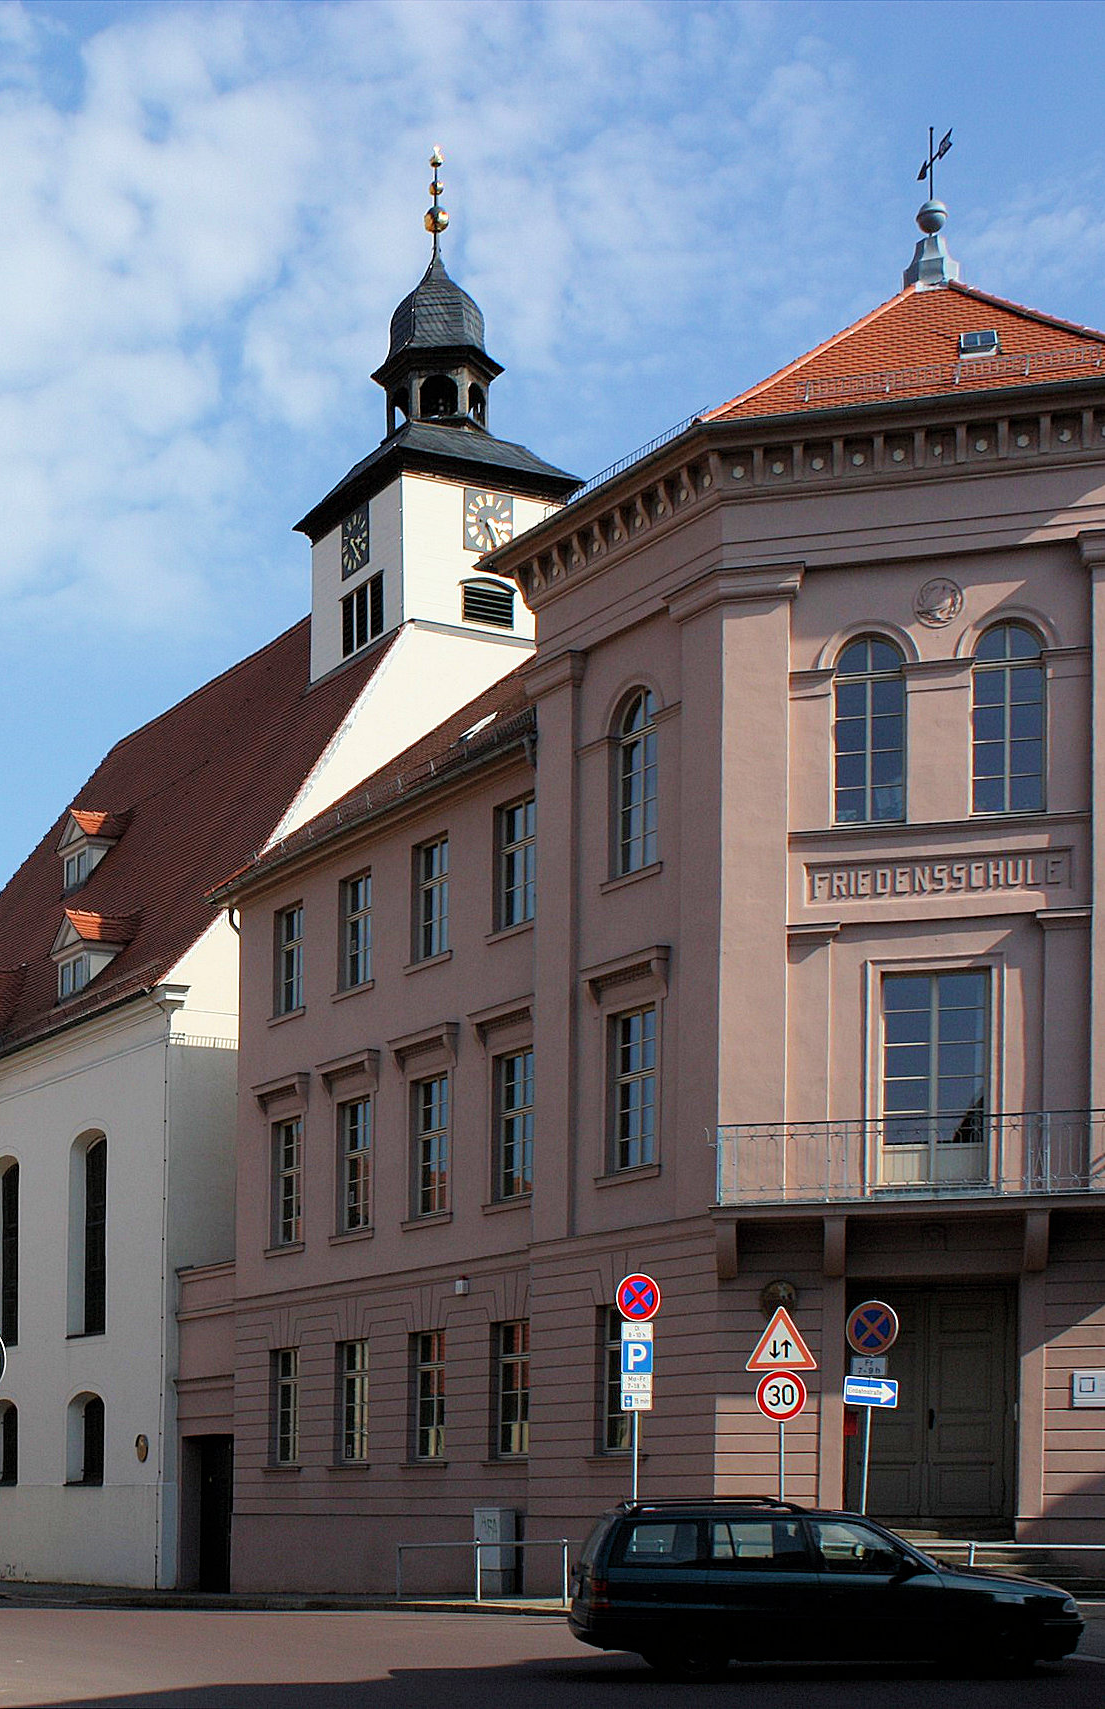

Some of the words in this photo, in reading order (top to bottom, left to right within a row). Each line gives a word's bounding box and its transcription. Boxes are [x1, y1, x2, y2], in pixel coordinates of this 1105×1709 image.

[813, 858, 1063, 899] FRIEDENSSCHULE
[628, 1343, 647, 1371] P
[768, 1384, 794, 1407] 30
